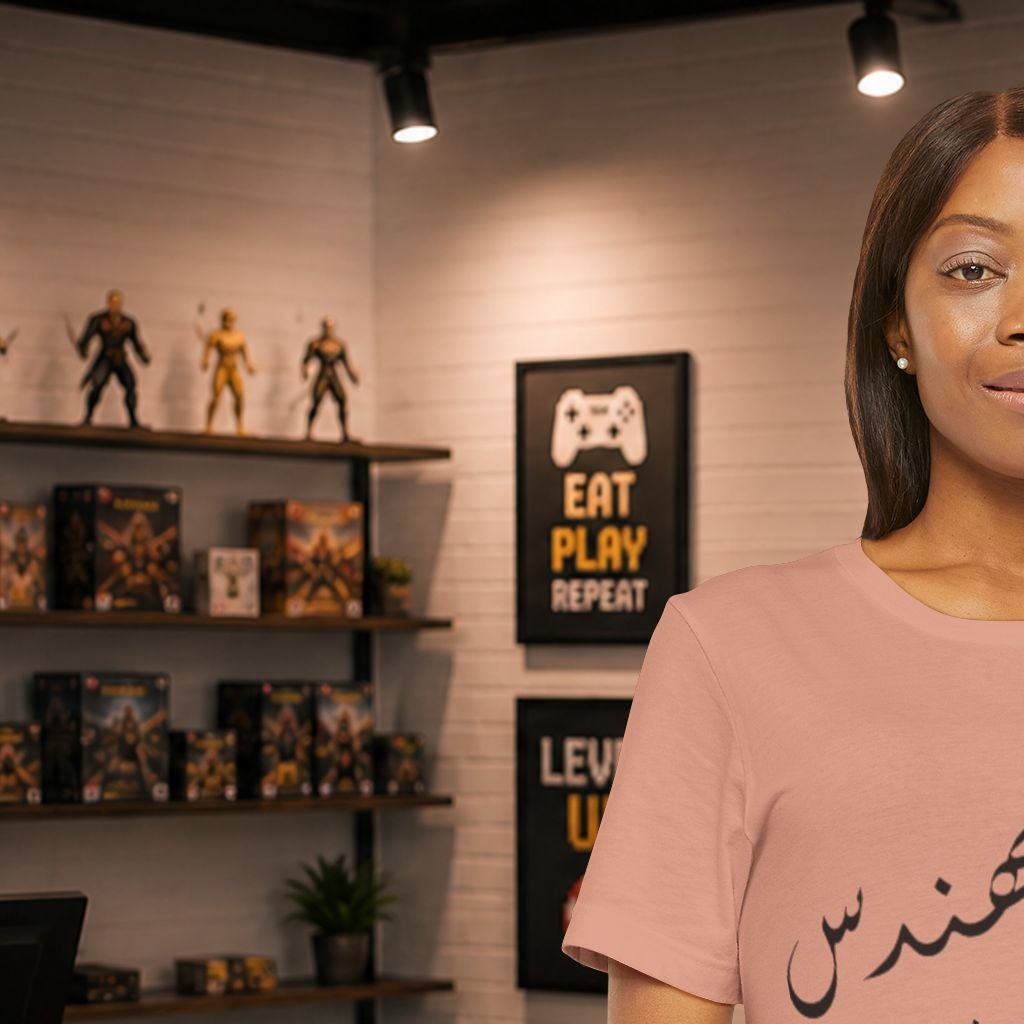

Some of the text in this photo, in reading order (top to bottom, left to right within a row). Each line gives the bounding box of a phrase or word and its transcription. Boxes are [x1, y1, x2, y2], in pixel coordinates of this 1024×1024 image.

[564, 471, 636, 519] EAT
[551, 526, 647, 572] PLAY
[551, 579, 648, 612] REPEAT
[540, 736, 623, 787] LEV
[566, 792, 610, 851] U
